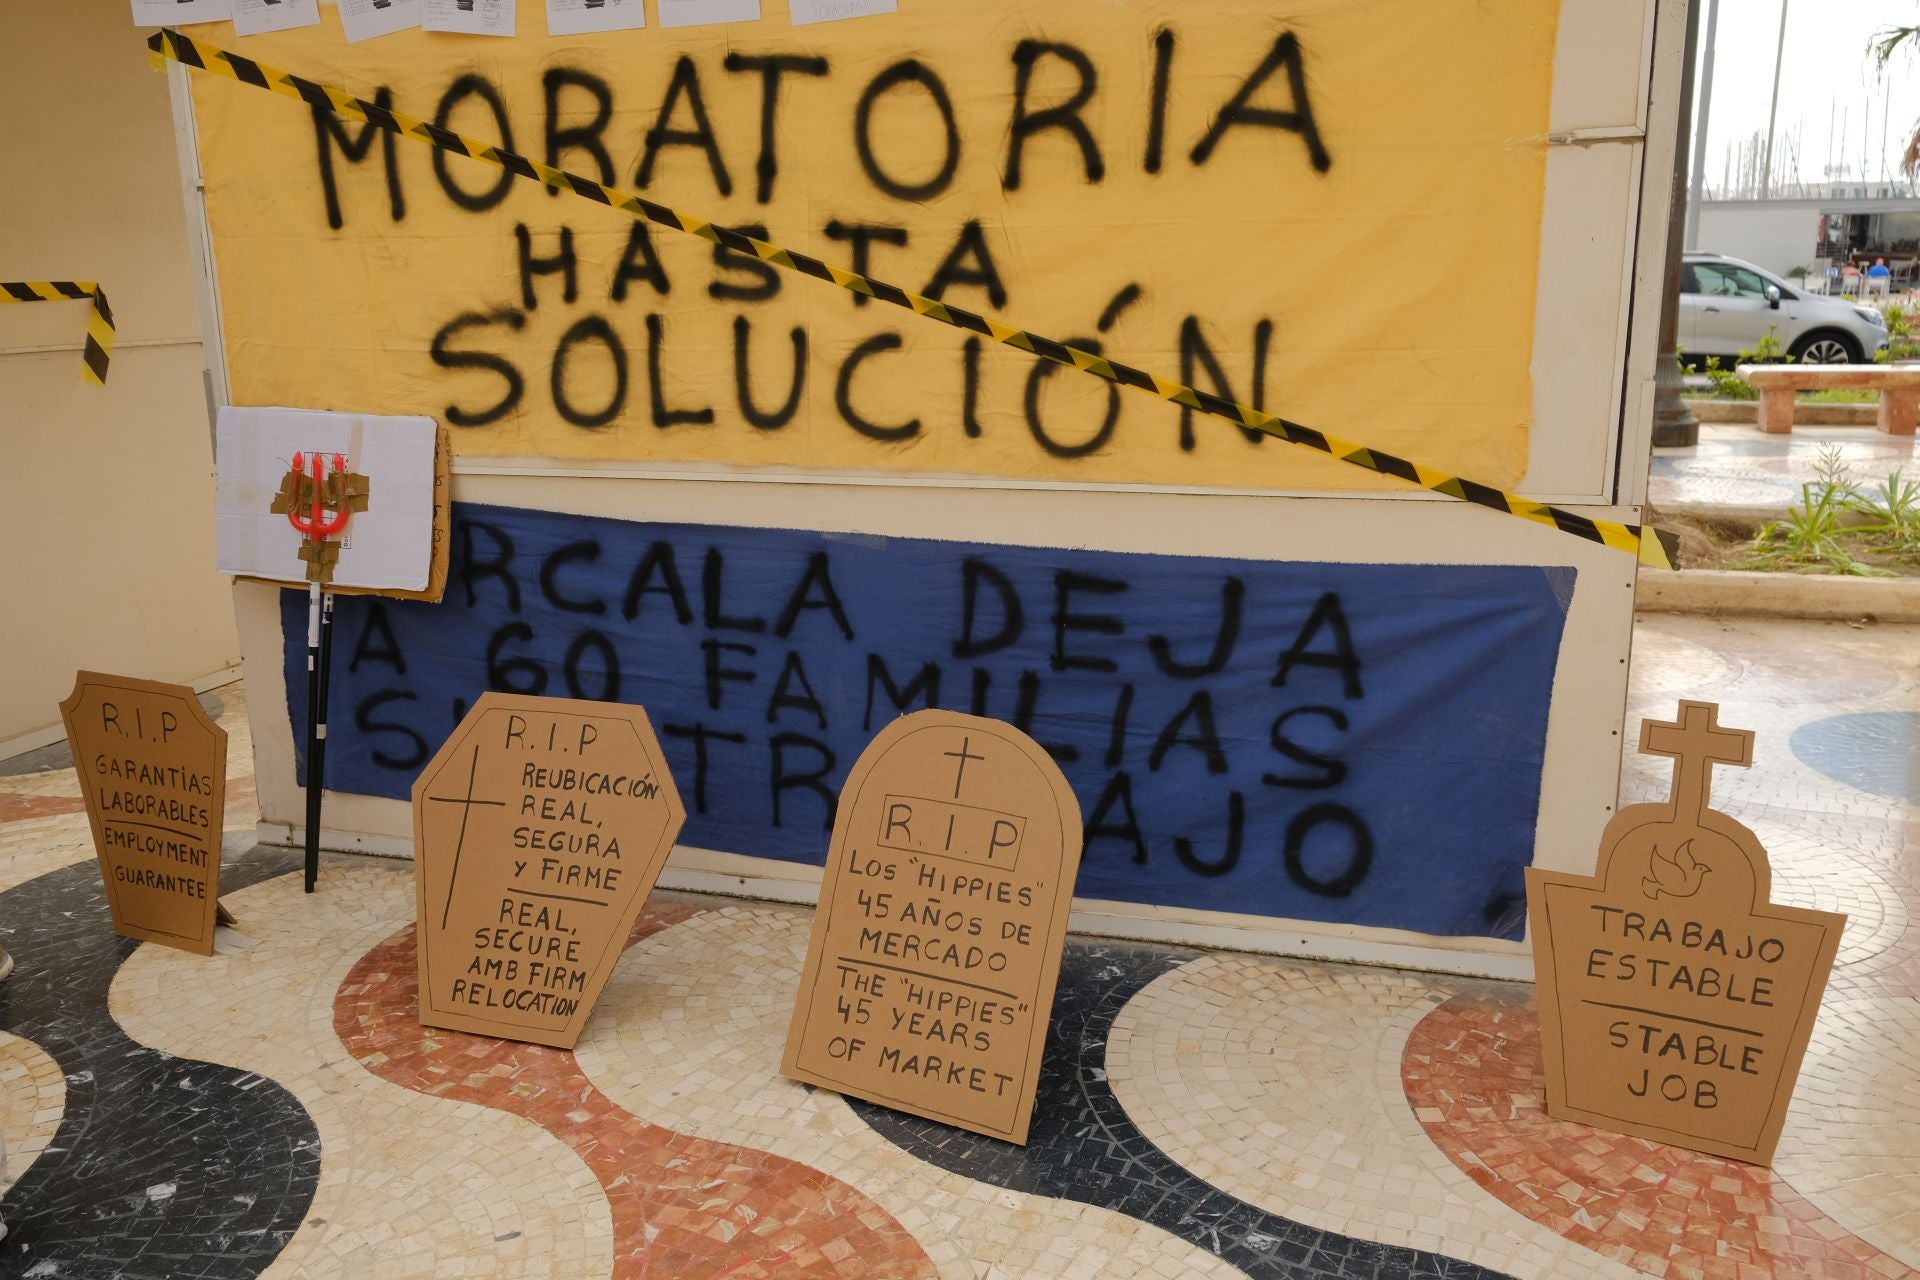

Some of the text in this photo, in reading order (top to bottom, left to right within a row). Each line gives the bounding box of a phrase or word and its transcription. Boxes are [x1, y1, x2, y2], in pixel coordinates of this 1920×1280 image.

[312, 26, 1332, 231] MORATORIA
[515, 219, 1006, 312] HASTA
[429, 282, 1274, 459] SOLUCIÓN
[458, 520, 1363, 699] RCALA DEJA
[486, 621, 621, 700] 60
[700, 636, 1349, 790] FAMILIAS
[96, 755, 212, 796] GARANTÍAS
[522, 762, 658, 800] REUBICACIÓN
[100, 788, 209, 827] LABORABLES
[521, 795, 604, 829] REAL,
[662, 720, 1373, 899] TRAJO
[104, 827, 209, 868] EMPLOYMENT
[513, 827, 621, 859] SEGURA
[115, 866, 205, 899] GUARANTEE
[541, 858, 622, 891] FIRME
[848, 849, 896, 881] LOS
[500, 899, 577, 937] REAL,
[857, 889, 1031, 946] 45 AÑOS DE
[1590, 905, 1784, 963] TRABAJO
[475, 928, 581, 962] SECURE
[859, 927, 1007, 972] MERCADO
[467, 956, 587, 993] AMB FIRM
[836, 965, 887, 997] THE
[1586, 949, 1773, 1007] ESTABLE
[451, 979, 579, 1016] RELOCATION
[837, 995, 990, 1052] 45 YEARS
[827, 1036, 1014, 1097] OF MARKET
[1608, 1021, 1764, 1075] STABLE
[1627, 1069, 1719, 1109] JOB
